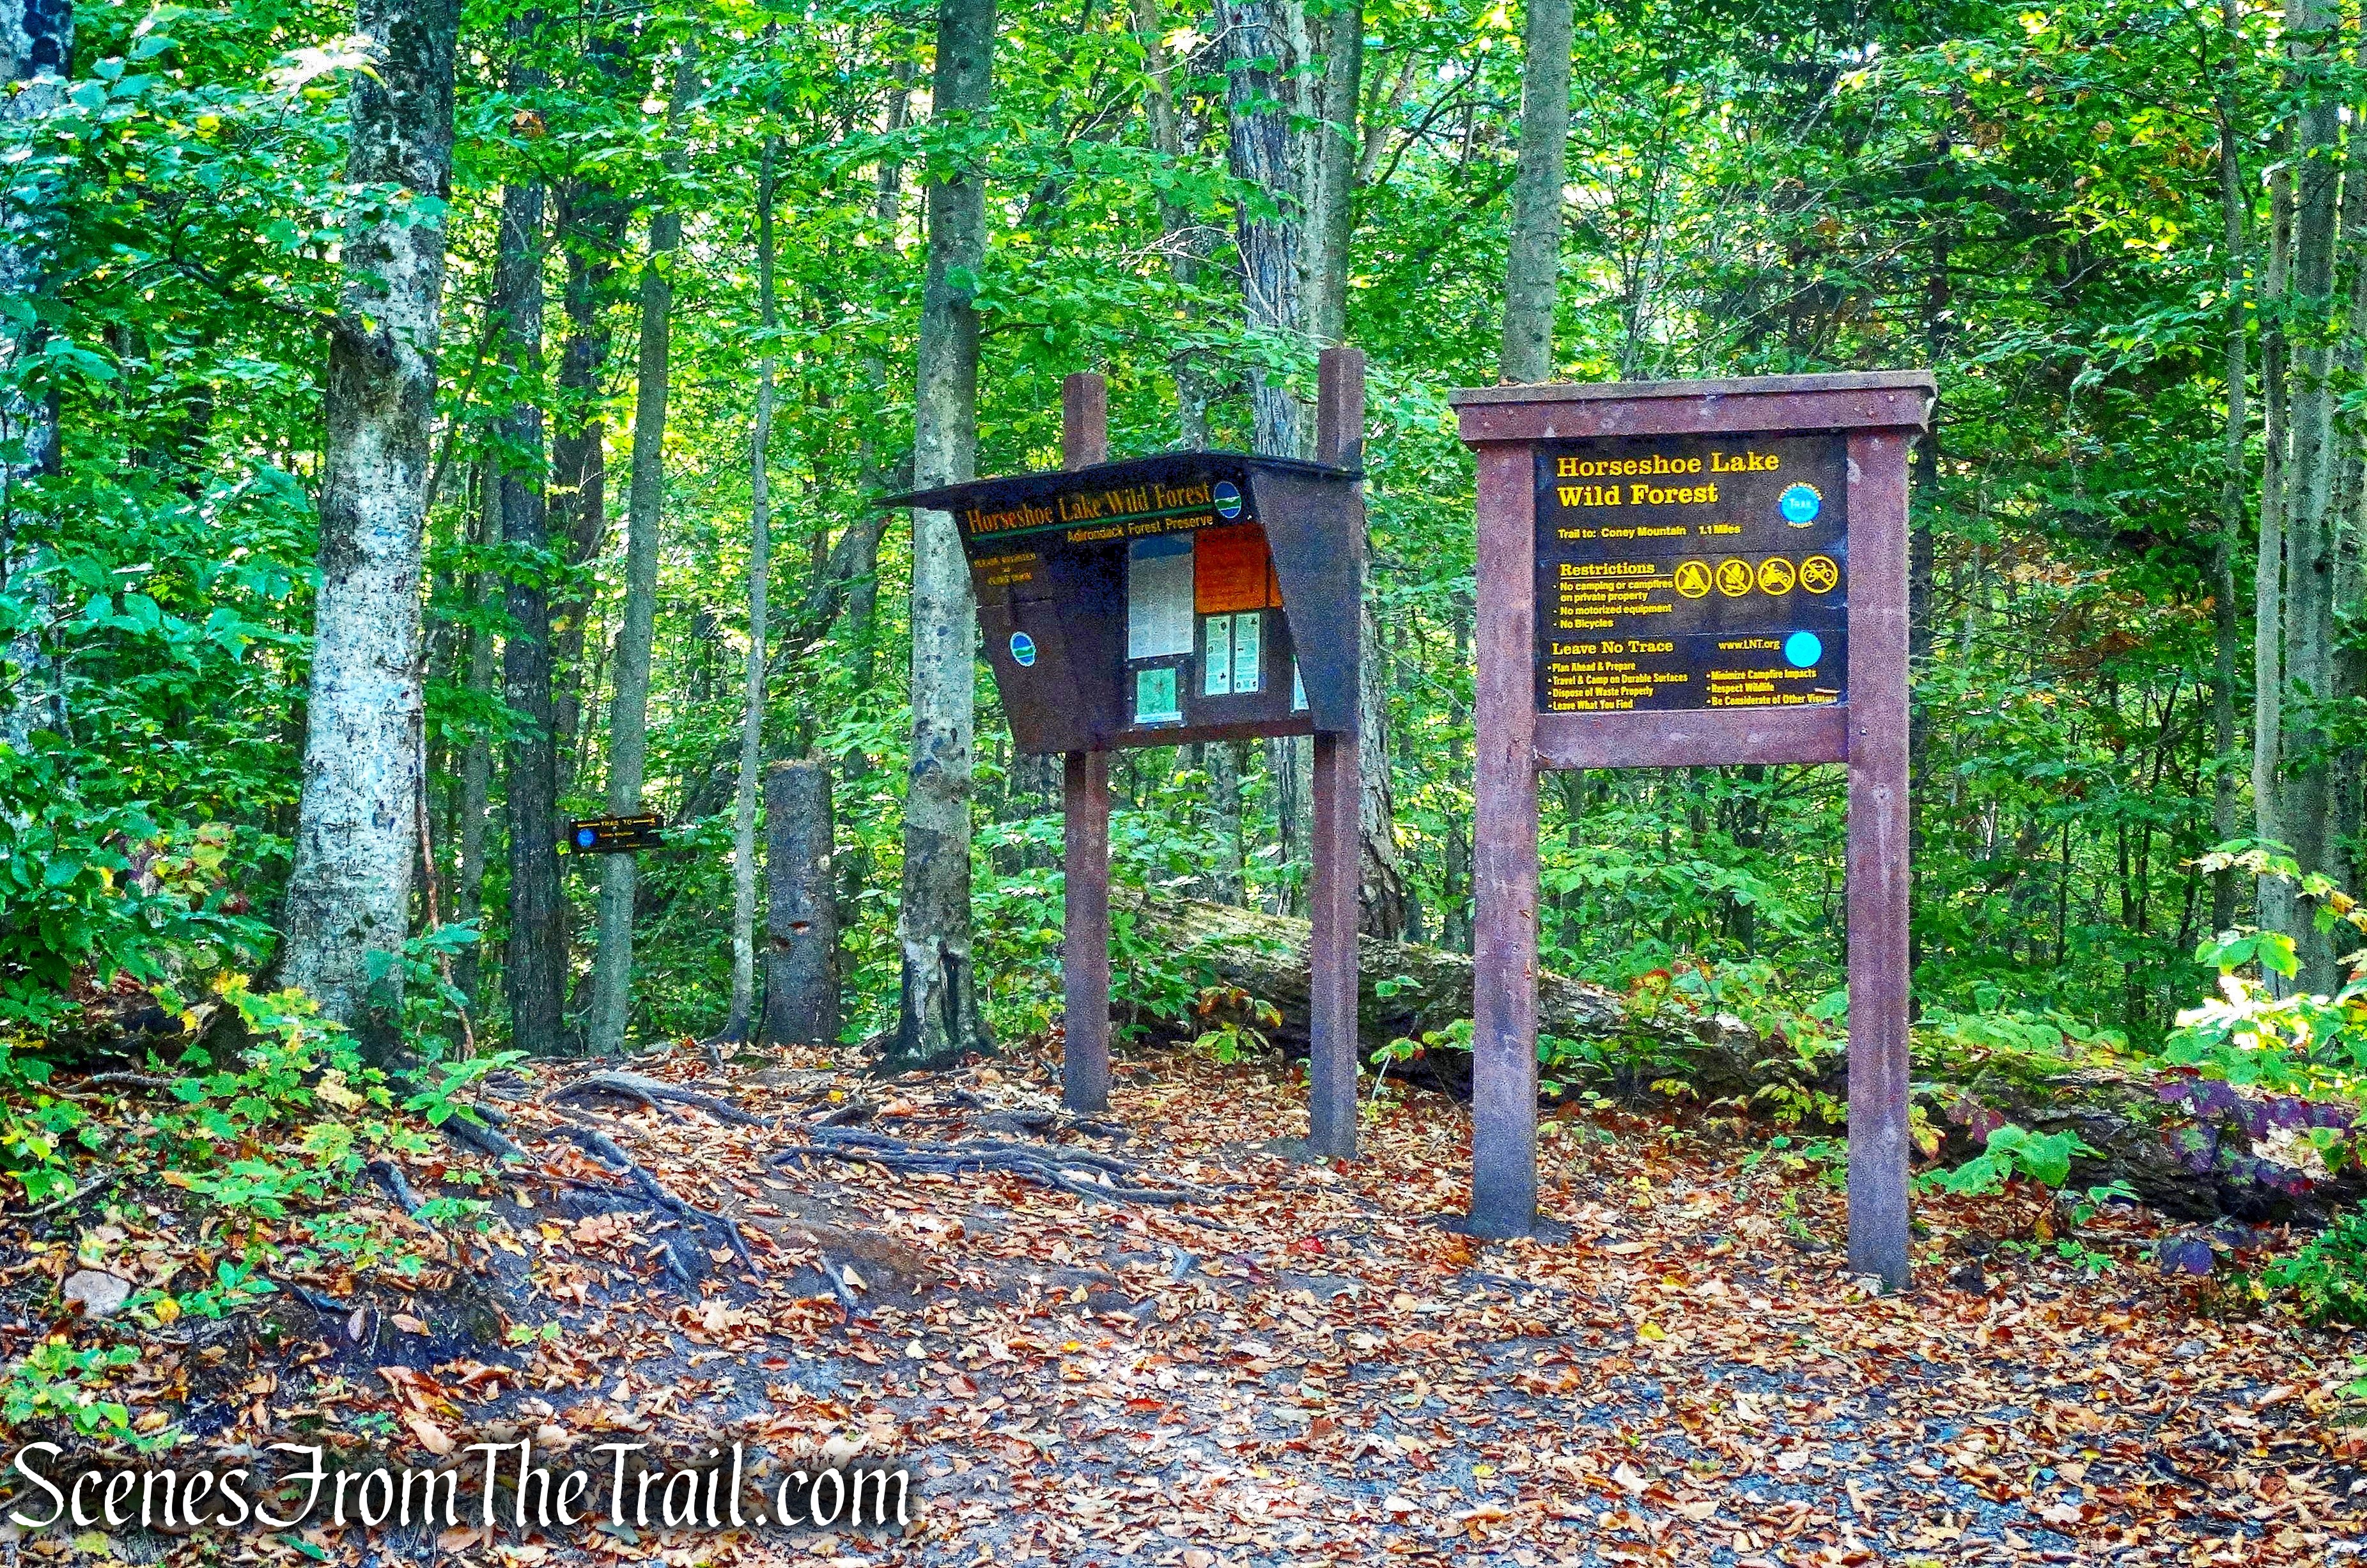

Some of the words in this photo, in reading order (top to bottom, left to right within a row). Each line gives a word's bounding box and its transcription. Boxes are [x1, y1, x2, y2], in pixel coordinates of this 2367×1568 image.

[1557, 453, 1702, 477] Horseshoe
[1711, 452, 1780, 473] Lake
[1557, 485, 1620, 507] Wild
[1630, 483, 1719, 504] Forest
[968, 502, 1054, 534] Horseshoe
[1059, 493, 1103, 522] Lake
[1105, 486, 1149, 515] Wild
[1155, 481, 1212, 509] Forest
[1067, 527, 1125, 543] Adirondack
[1129, 520, 1161, 536] Forest
[1166, 515, 1214, 531] Preserve
[1558, 529, 1579, 539] Trail
[1581, 529, 1597, 539] to:
[1601, 528, 1634, 539] Coney
[1638, 526, 1687, 537] Mountain
[1714, 524, 1742, 534] Miles
[1560, 563, 1656, 577] Restrictions
[1560, 582, 1574, 591] No
[1575, 581, 1615, 592] camping
[1628, 580, 1673, 590] campfires
[1560, 594, 1572, 602] on
[1574, 592, 1606, 603] private
[1608, 591, 1649, 602] property
[1560, 607, 1574, 616] No
[1575, 605, 1622, 615] motorized
[1623, 603, 1673, 616] equipment
[1560, 619, 1574, 629] No
[1574, 618, 1614, 629] Bicycles
[1552, 642, 1597, 656] Leave
[1601, 641, 1624, 654] No
[1628, 640, 1673, 653] Trace
[1718, 639, 1780, 649] www.LNT.org
[1552, 663, 1570, 672] Plan
[1571, 662, 1596, 671] Ahead
[1597, 661, 1604, 671] &
[1605, 661, 1636, 672] Prepare
[1553, 675, 1576, 685] Travel
[1577, 675, 1583, 684] &
[1586, 674, 1608, 685] Camp
[1622, 673, 1652, 683] Durable
[1653, 672, 1688, 682] Surfaces
[1711, 671, 1746, 680] Minimize
[1748, 669, 1783, 680] Campfire
[1785, 669, 1817, 679] Impacts
[1553, 688, 1583, 699] Dispose
[1585, 687, 1594, 696] of
[1594, 687, 1619, 696] Waste
[1620, 685, 1654, 697] Properly
[1712, 683, 1743, 694] Respect
[1745, 682, 1774, 692] Wildlife
[1553, 701, 1576, 710] Leave
[1577, 701, 1598, 710] What
[1600, 700, 1615, 709] You
[1616, 699, 1633, 708] Find
[1712, 696, 1723, 706] Be
[1725, 694, 1771, 704] Considerate
[1772, 694, 1781, 704] of
[1783, 693, 1806, 703] Other
